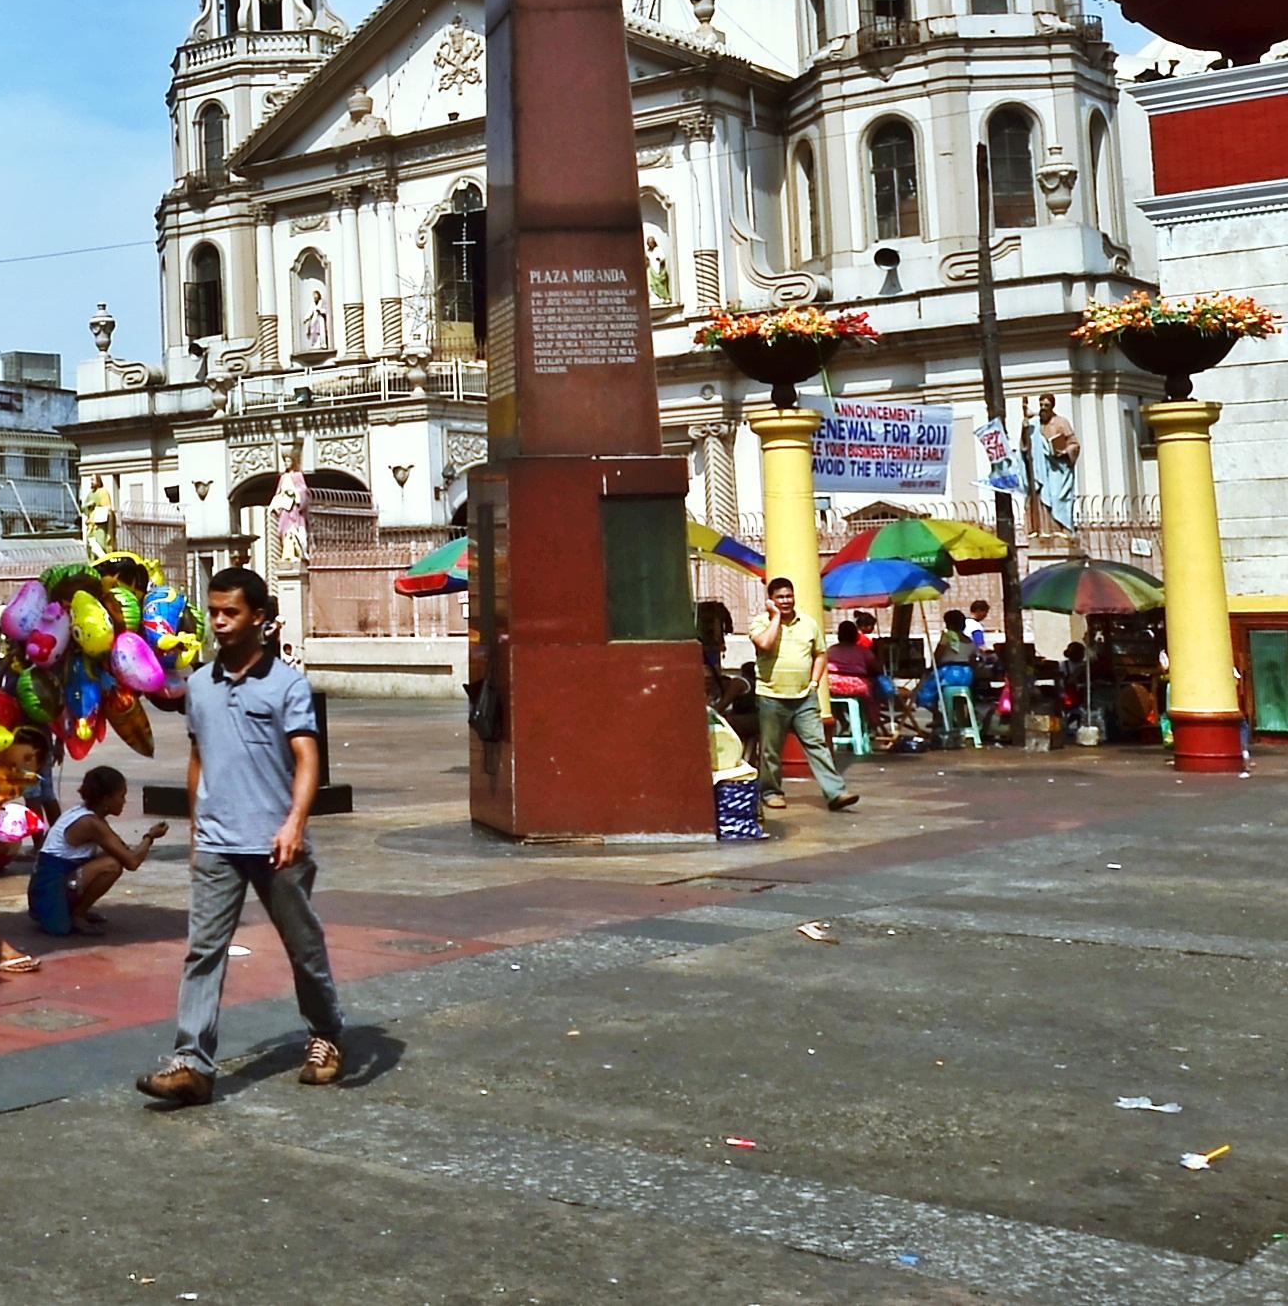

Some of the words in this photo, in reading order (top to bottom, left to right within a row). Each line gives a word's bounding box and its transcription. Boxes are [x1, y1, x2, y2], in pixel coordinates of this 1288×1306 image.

[529, 270, 568, 284] PLAZA
[573, 269, 627, 283] MIRANDA
[834, 402, 916, 422] ANNOUNCEMENT
[812, 418, 876, 442] ENEWAL
[884, 424, 910, 444] FOR
[917, 425, 947, 445] 2011
[825, 442, 846, 458] YOUR
[848, 444, 885, 459] BUSINESS
[886, 446, 921, 461] PERMITS
[922, 447, 945, 462] EARLY
[811, 458, 845, 476] AVOID
[851, 461, 871, 478] THE
